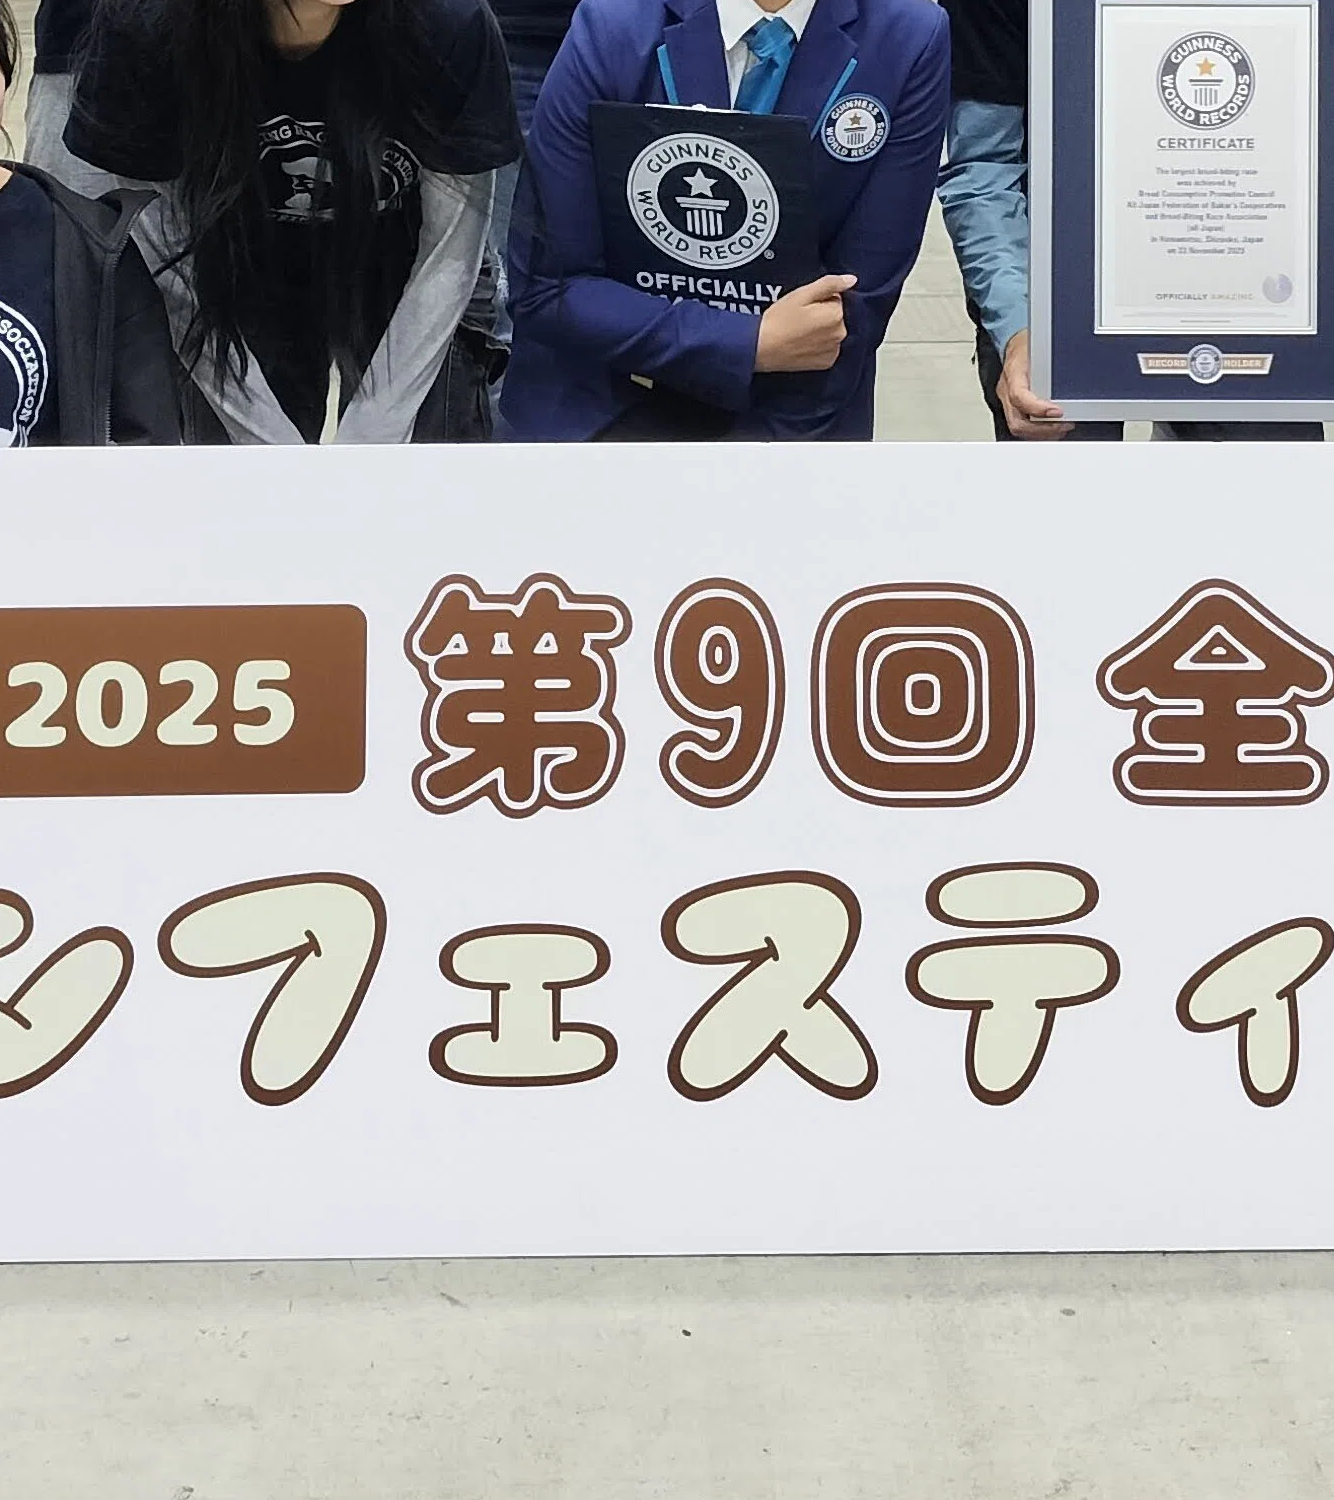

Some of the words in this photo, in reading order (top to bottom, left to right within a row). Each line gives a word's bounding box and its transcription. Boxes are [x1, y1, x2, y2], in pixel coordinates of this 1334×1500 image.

[1169, 37, 1243, 64] GUINNESS
[830, 99, 880, 120] GUINNESS
[1162, 74, 1196, 121] WORLD
[1199, 74, 1250, 125] RECORDS
[825, 126, 849, 156] WORLD
[850, 121, 885, 157] RECORDS
[1156, 137, 1256, 149] CERTIFICATE
[646, 141, 755, 182] GUINNESS
[636, 189, 690, 253] WORLD
[699, 197, 769, 261] RECORDS
[635, 271, 783, 303] OFFICIALLY
[1155, 293, 1208, 301] OFFICIALLY
[1147, 358, 1188, 367] RECORD
[1223, 358, 1263, 368] HOLDER
[4, 657, 296, 749] 2025
[402, 572, 1036, 819] 第9回
